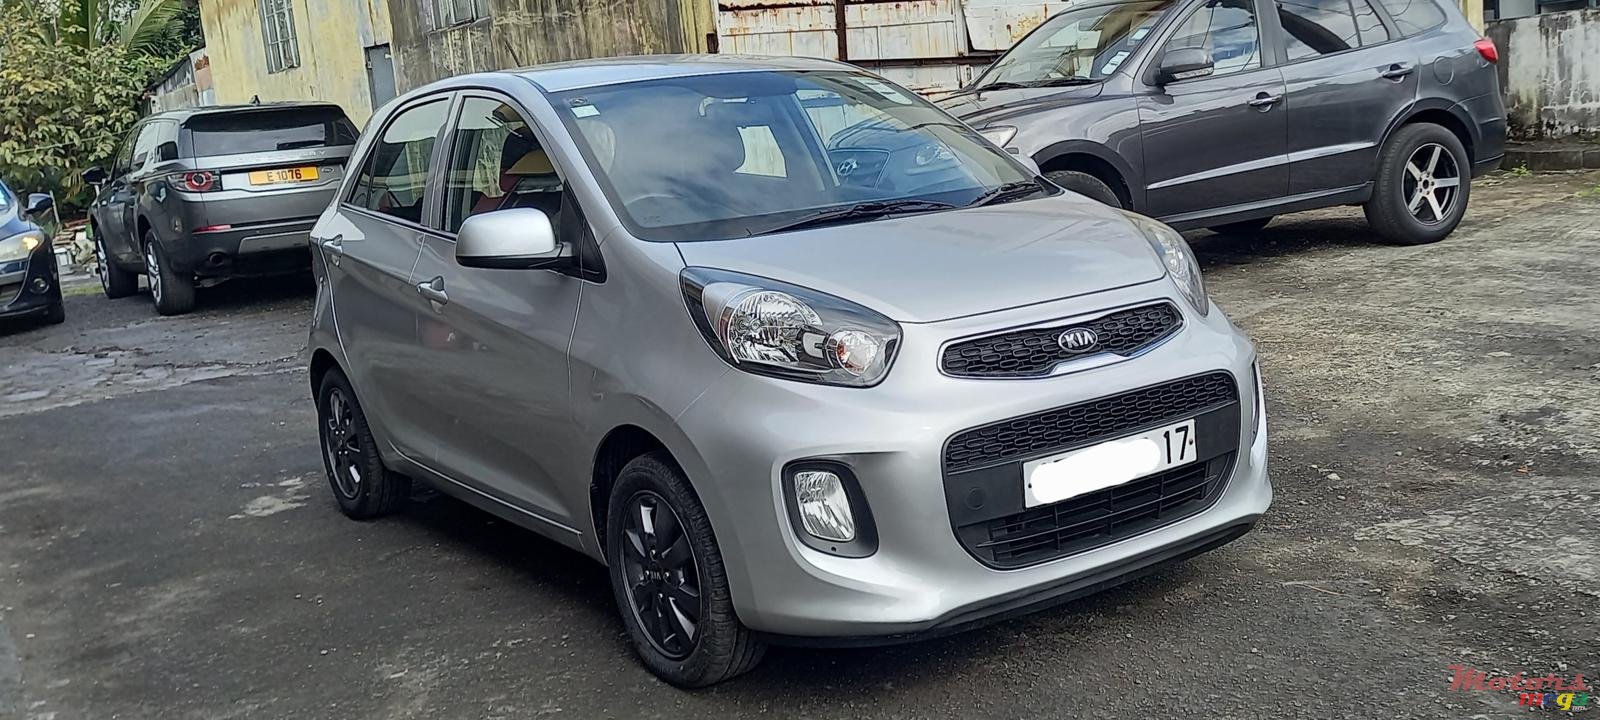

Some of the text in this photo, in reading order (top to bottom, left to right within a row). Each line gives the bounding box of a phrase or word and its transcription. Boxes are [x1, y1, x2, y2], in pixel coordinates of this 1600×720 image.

[267, 169, 302, 182] E 1076
[1063, 330, 1095, 349] KIA
[1163, 425, 1189, 464] 17
